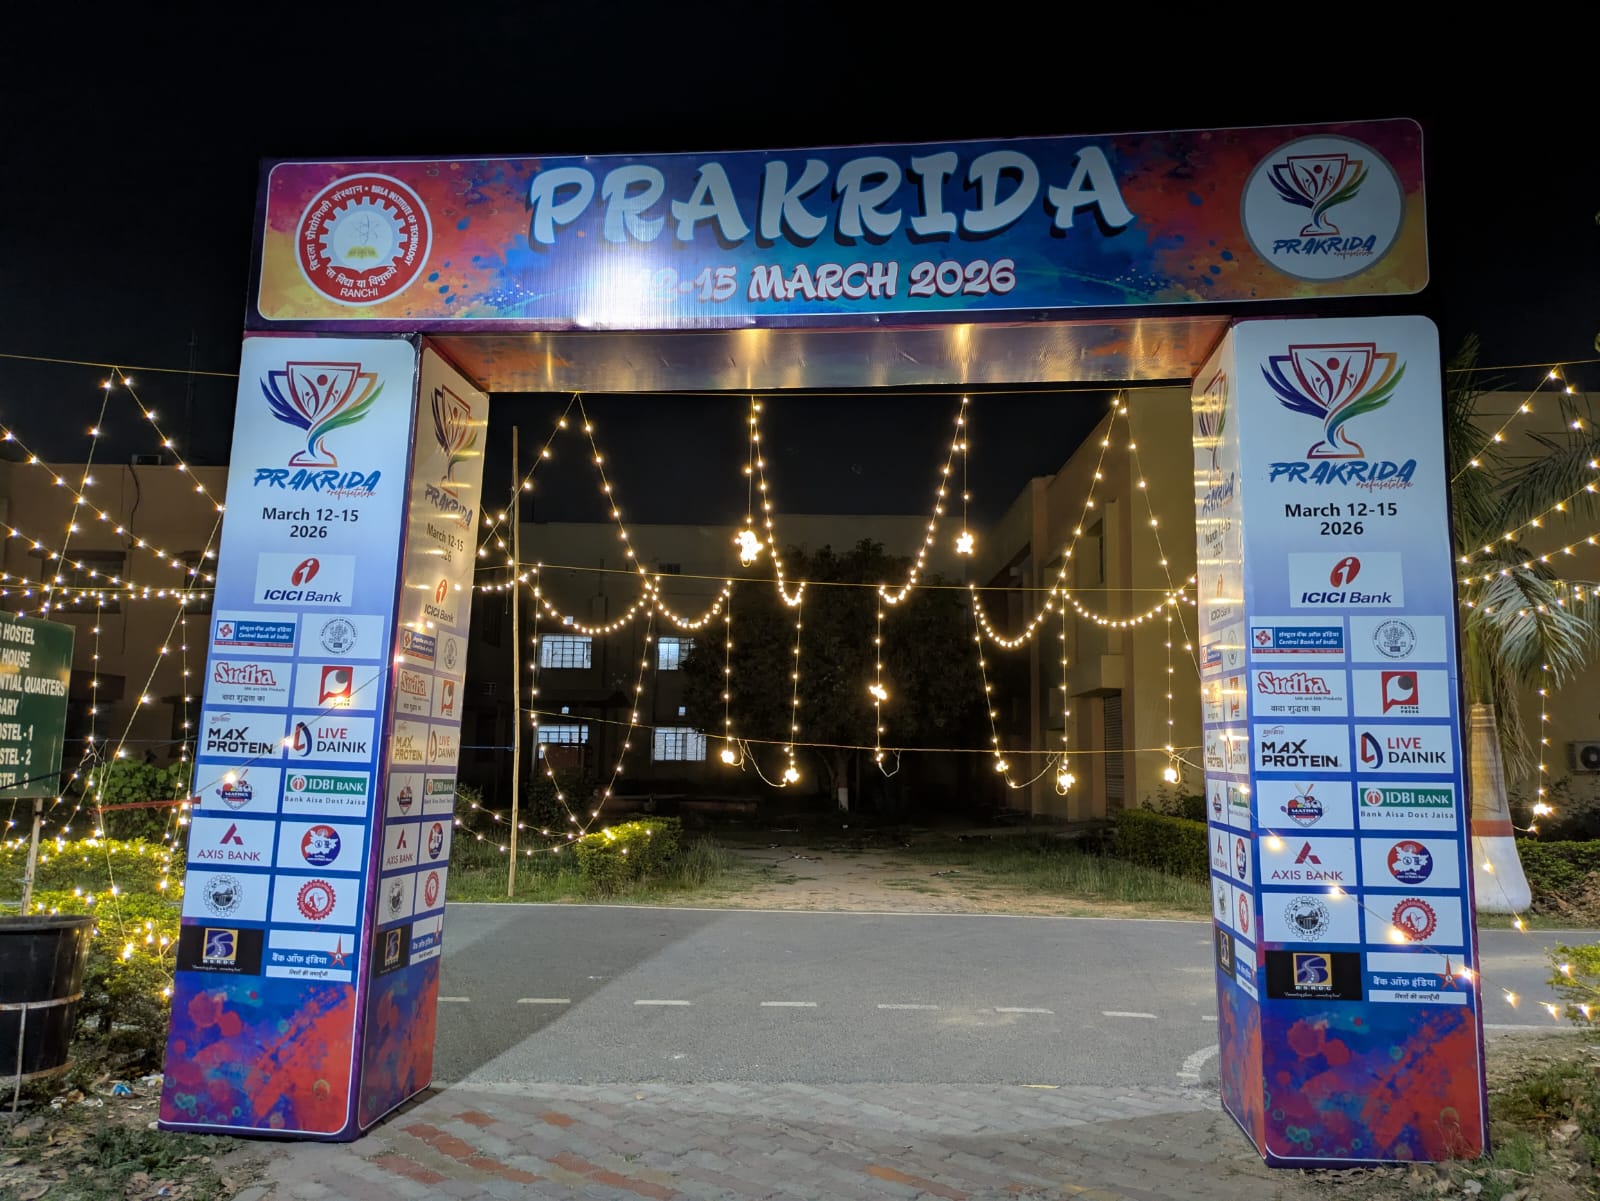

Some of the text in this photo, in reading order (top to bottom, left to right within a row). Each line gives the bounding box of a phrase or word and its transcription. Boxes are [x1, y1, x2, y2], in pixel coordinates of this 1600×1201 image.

[530, 146, 1135, 244] PRAKRIDA
[1273, 235, 1377, 255] PRAKRIDA
[749, 261, 898, 302] MARCH
[907, 258, 1017, 299] 2026
[340, 287, 379, 298] RANCHI
[1268, 459, 1417, 486] PRAKRIDA
[254, 468, 381, 493] PRAKRIDA
[262, 507, 359, 522] March 12-15
[1285, 503, 1397, 517] March 12-15
[290, 525, 328, 538] 2026
[427, 523, 446, 543] March
[1320, 522, 1364, 535] 2026
[264, 590, 342, 602] ICICI Bank
[1301, 592, 1392, 603] ICICI Bank
[3, 623, 35, 645] HOSTEL
[2, 647, 31, 668] HOUSE
[214, 662, 277, 686] Sudha
[24, 675, 65, 696] QUARTERS
[1257, 672, 1331, 695] Sudha
[208, 726, 249, 740] MAX
[317, 728, 348, 739] LIVE
[207, 740, 274, 755] PROTEIN
[317, 741, 367, 753] DAINIK
[1261, 739, 1307, 754] MAX
[1388, 737, 1422, 749] LIVE
[25, 748, 32, 766] 2
[1262, 755, 1338, 768] PROTEIN
[1388, 752, 1446, 763] DAINIK
[309, 778, 364, 792] IDBI BANK
[1386, 791, 1449, 804] IDBI BANK
[197, 849, 261, 861] AXIS BANK
[1271, 870, 1343, 881] AXIS BANK
